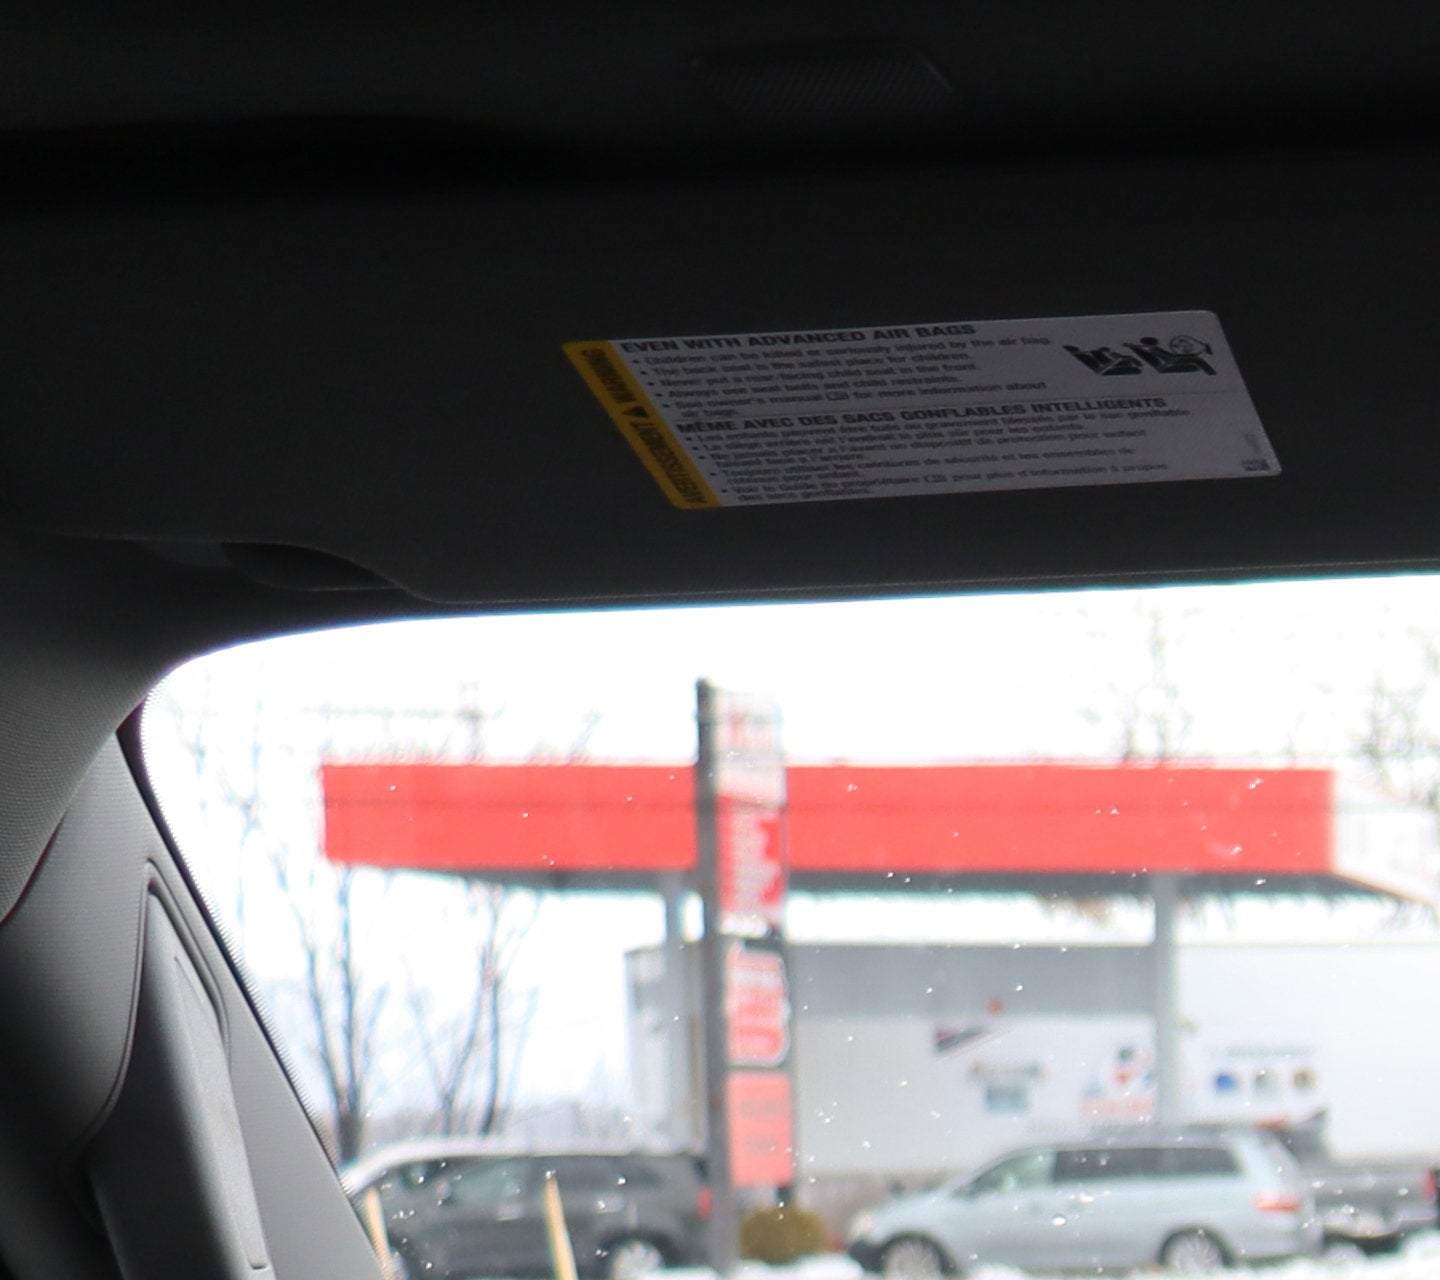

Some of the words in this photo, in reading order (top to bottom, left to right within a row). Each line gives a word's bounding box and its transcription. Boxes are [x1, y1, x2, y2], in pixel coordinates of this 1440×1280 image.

[621, 341, 679, 353] EVEN
[683, 338, 740, 349] WITH
[747, 331, 866, 346] ADVANCED
[873, 328, 911, 339] AIR
[915, 325, 976, 337] BAGS
[743, 417, 795, 430] AVEC
[798, 415, 838, 427] DES
[841, 411, 897, 424] SACS
[900, 404, 1026, 421] GONFLABLES
[1033, 398, 1167, 412] INTELLIGENTS
